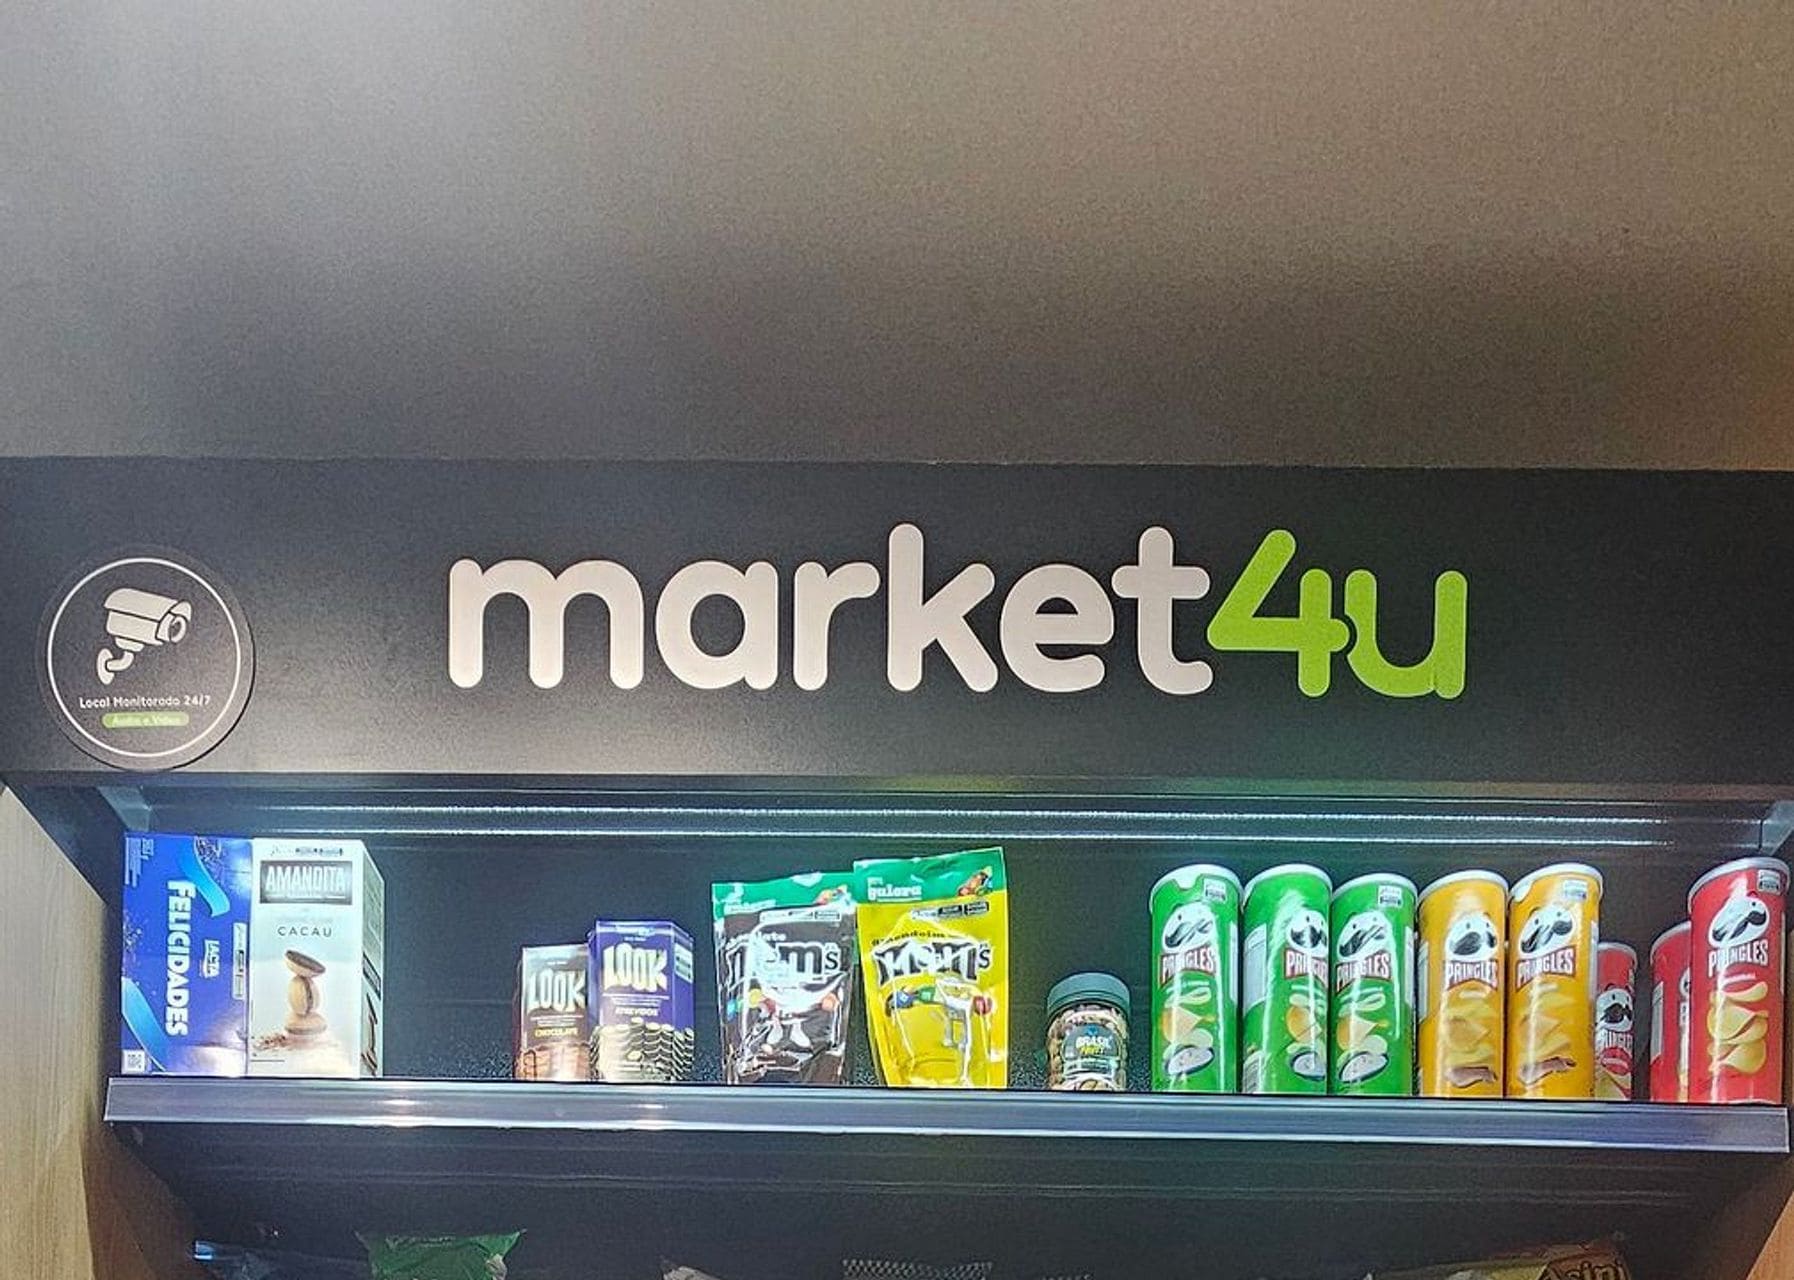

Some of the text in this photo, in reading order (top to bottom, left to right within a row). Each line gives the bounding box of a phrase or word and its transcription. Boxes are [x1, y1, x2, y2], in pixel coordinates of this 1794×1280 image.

[448, 524, 1468, 700] market4u
[79, 696, 110, 709] Local
[265, 865, 347, 895] AMANDITA
[277, 925, 333, 938] CACAU
[166, 879, 196, 1037] FELICIDADES
[602, 941, 668, 993] LOOK
[1446, 961, 1499, 990] PRINGLES
[526, 967, 587, 1015] LOOK
